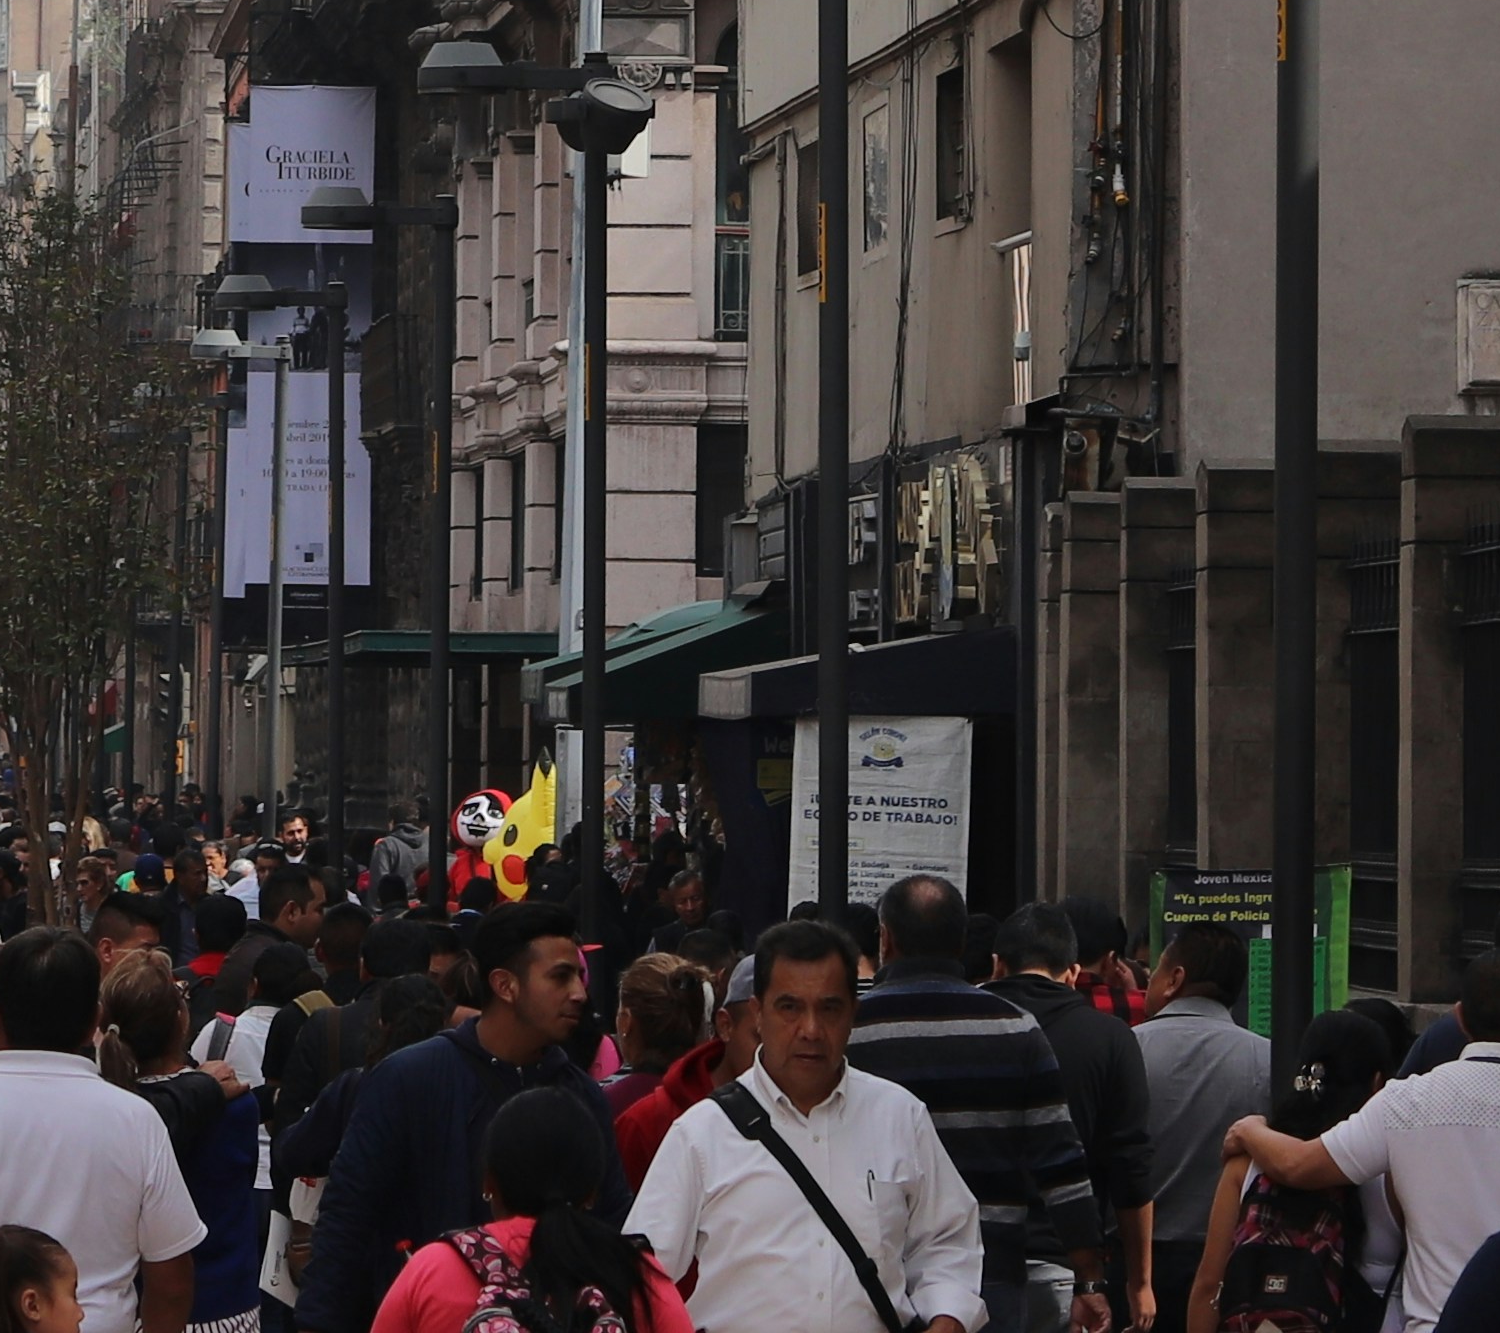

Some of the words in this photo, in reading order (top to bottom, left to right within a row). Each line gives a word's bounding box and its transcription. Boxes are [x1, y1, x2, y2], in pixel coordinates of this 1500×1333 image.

[265, 145, 350, 164] GRACIELA
[277, 162, 356, 181] ITURBIDE
[866, 795, 876, 806] A
[881, 795, 948, 809] NUESTRO
[863, 812, 881, 822] DE
[886, 813, 957, 825] TRABAJO!
[1194, 874, 1229, 884] Joven
[1232, 874, 1272, 883] Mexica
[1199, 893, 1241, 906] puedes
[1212, 911, 1226, 921] de
